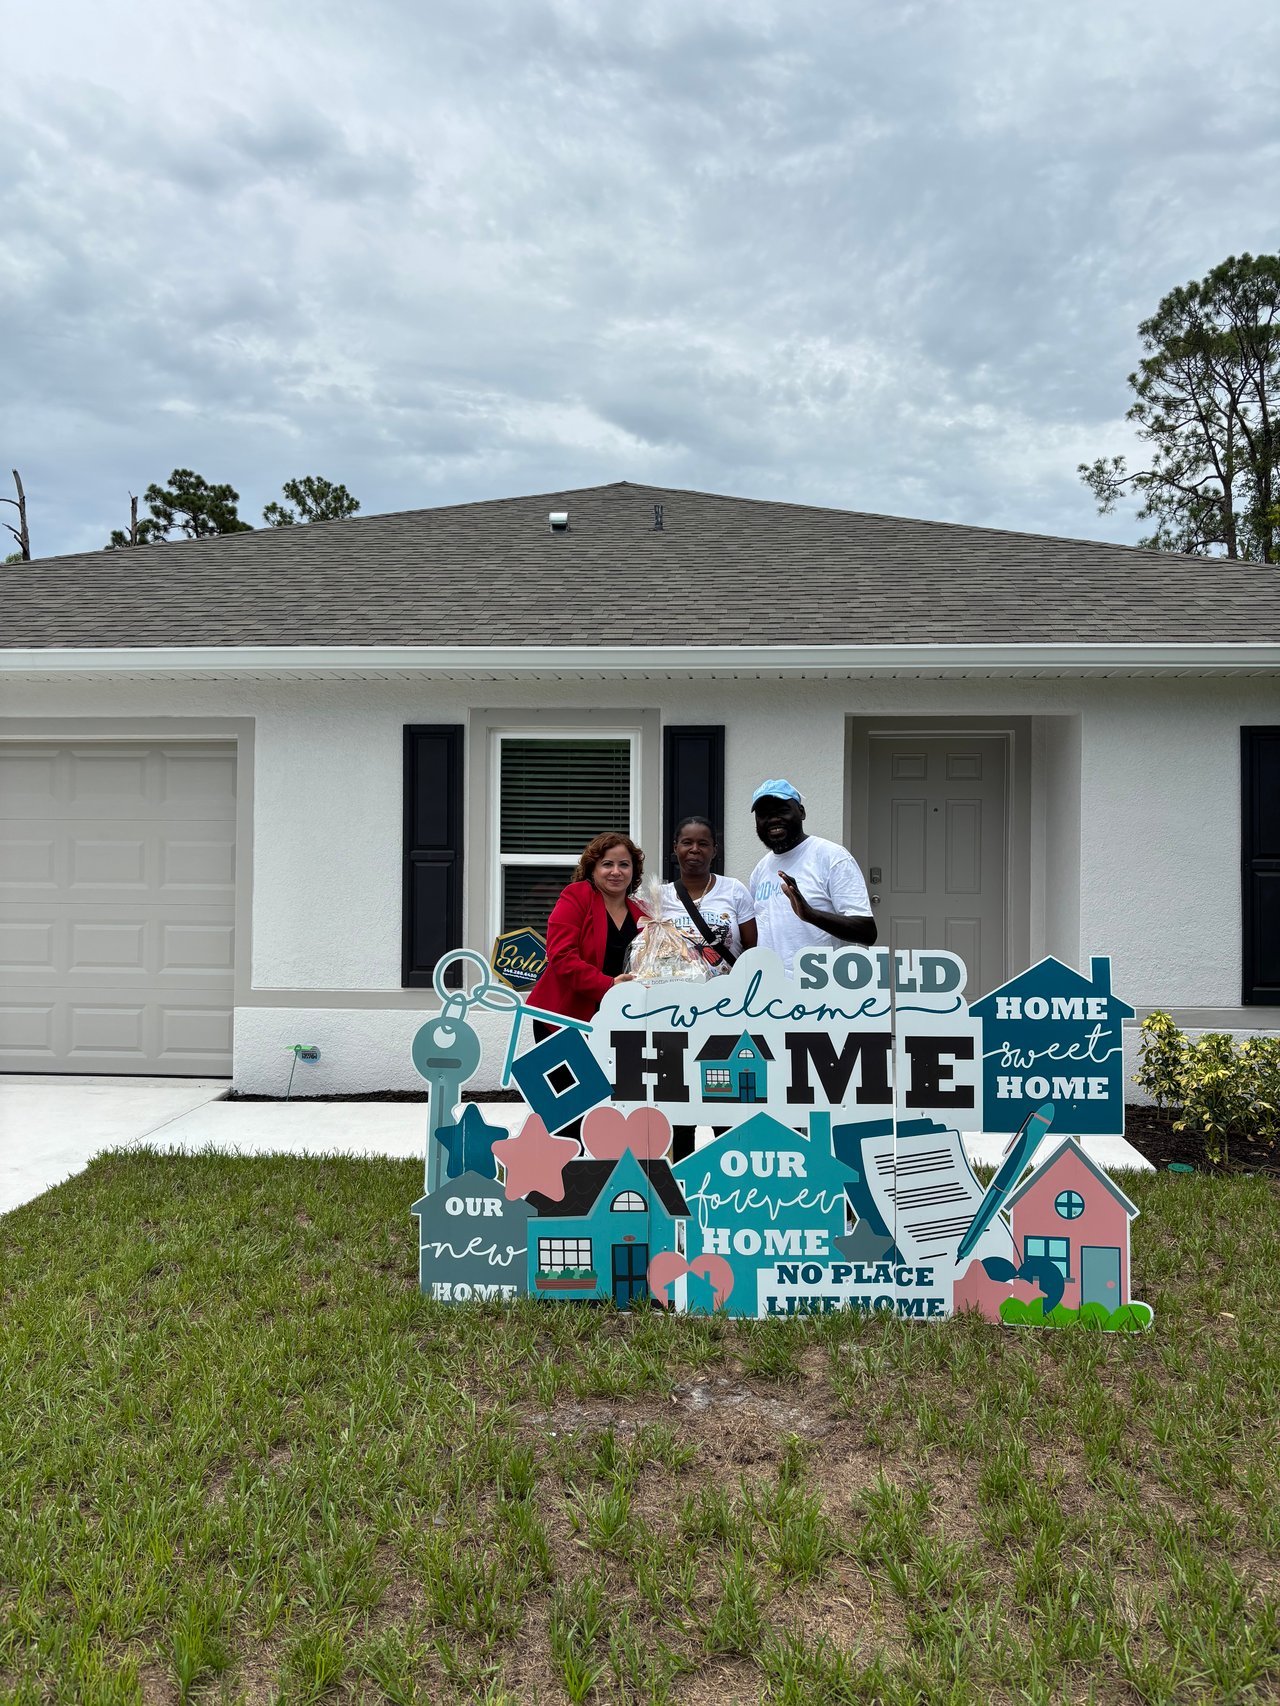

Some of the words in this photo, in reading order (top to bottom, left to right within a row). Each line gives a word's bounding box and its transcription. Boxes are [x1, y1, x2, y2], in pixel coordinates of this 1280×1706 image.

[496, 945, 548, 973] Sold
[800, 953, 960, 993] SOLD
[622, 970, 961, 1027] welcome
[996, 997, 1108, 1020] HOME
[983, 1023, 1122, 1068] sweet
[610, 1030, 975, 1109] HME
[997, 1076, 1109, 1099] HOME
[719, 1150, 807, 1178] OUR
[445, 1197, 504, 1217] OUR
[686, 1172, 845, 1229] forever
[421, 1236, 528, 1267] new
[702, 1228, 829, 1256] HOME
[777, 1264, 823, 1284] NO
[832, 1264, 934, 1287] PLACE
[432, 1282, 518, 1302] HOME
[766, 1296, 841, 1317] LIKE
[849, 1295, 945, 1317] HOME
